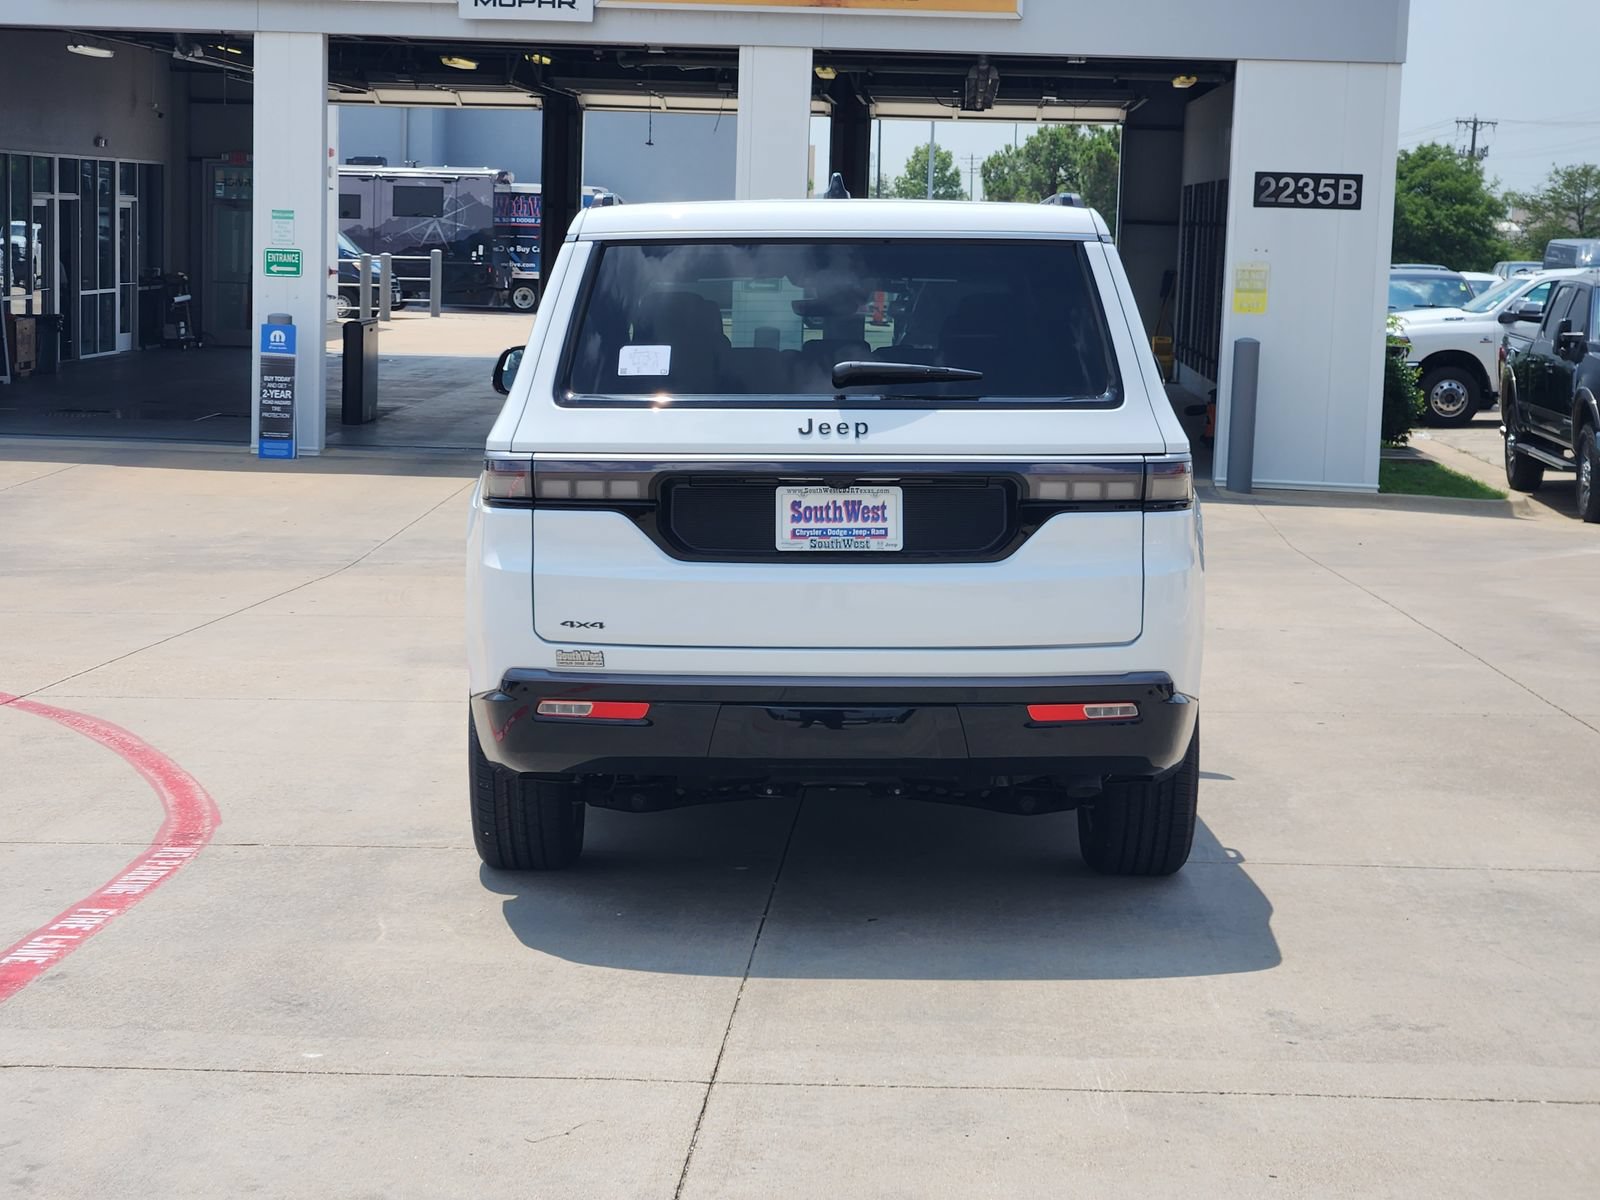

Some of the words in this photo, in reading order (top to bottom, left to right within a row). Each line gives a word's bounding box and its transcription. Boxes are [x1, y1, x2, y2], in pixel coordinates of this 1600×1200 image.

[474, 0, 577, 9] MOPAR
[1258, 176, 1358, 205] 2235B
[516, 245, 530, 254] Buy
[267, 253, 300, 263] ENTRANCE
[262, 389, 292, 399] 2-YEAR
[798, 418, 869, 439] Jeep
[790, 500, 888, 524] SouthWest
[795, 528, 822, 538] Chrysler
[827, 528, 848, 537] Dodge
[852, 528, 867, 538] Jeep
[871, 528, 885, 536] Ram
[809, 538, 871, 549] SouthWest
[560, 621, 605, 629] 4x4
[102, 860, 182, 894] PARKING
[49, 908, 119, 931] FIRE
[0, 935, 80, 964] LANE
